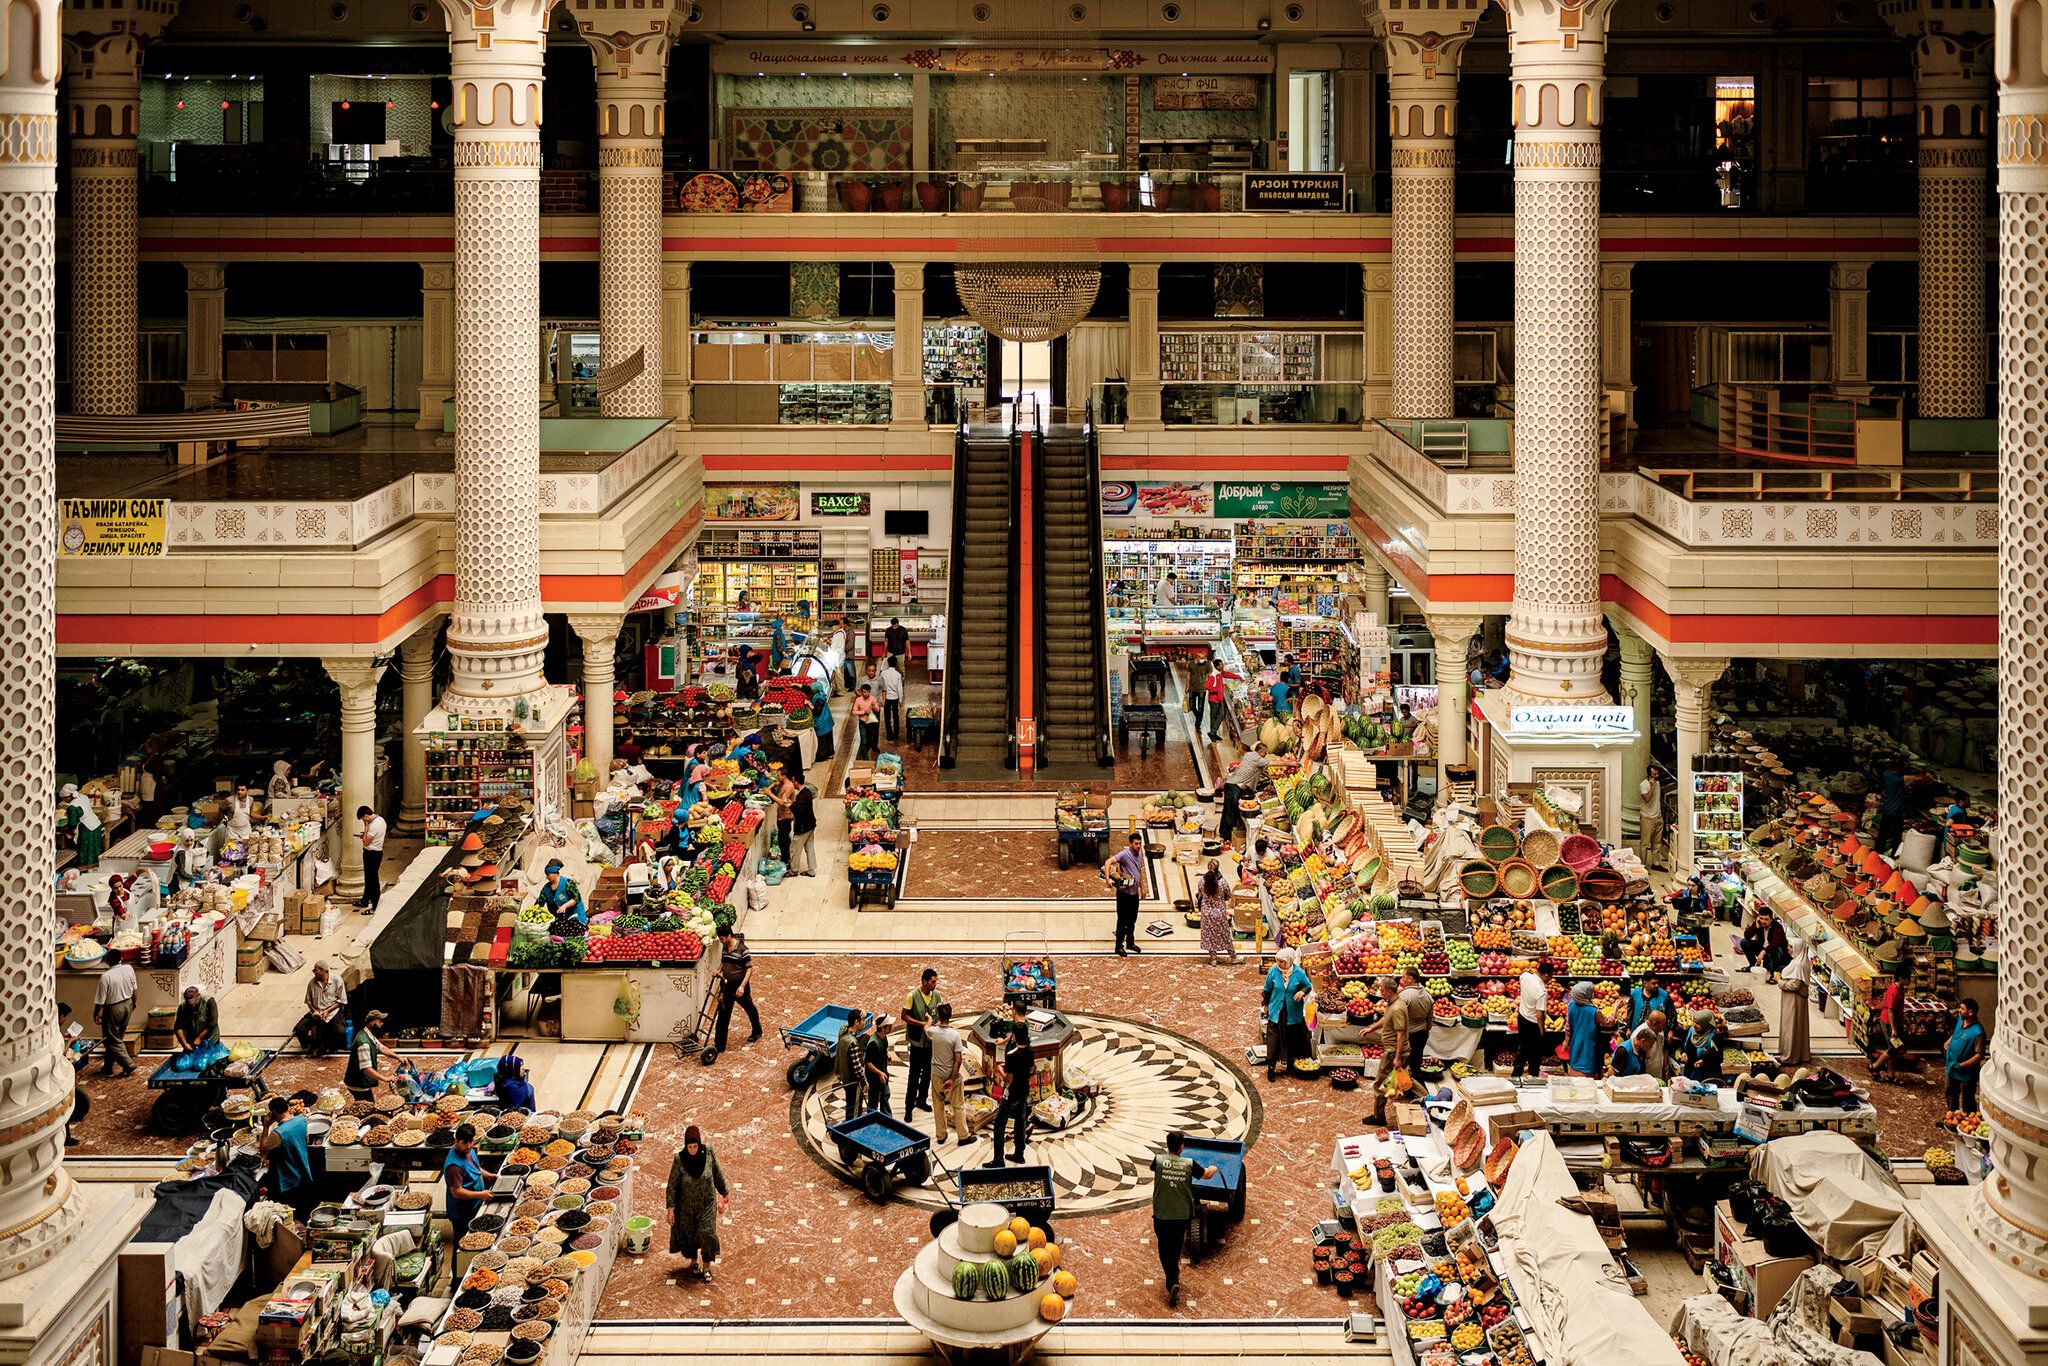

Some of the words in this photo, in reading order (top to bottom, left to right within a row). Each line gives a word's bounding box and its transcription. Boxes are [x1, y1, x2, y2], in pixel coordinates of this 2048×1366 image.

[749, 51, 847, 65] Национальная
[853, 54, 889, 65] кухня
[1222, 55, 1269, 63] милли
[1162, 78, 1191, 89] ФАСТ
[1196, 78, 1218, 89] ФУД
[1250, 180, 1290, 189] АРЗОН
[1291, 180, 1339, 189] ТУРКИЯ
[1297, 191, 1330, 200] МАРДОНА
[63, 500, 127, 519] ТАЪМИРИ
[131, 499, 164, 518] СОАТ
[80, 542, 125, 556] РЕМОНТ
[128, 541, 163, 556] ЧАСОВ
[1514, 711, 1584, 723] Олами
[1592, 711, 1626, 723] чой
[1039, 1199, 1052, 1208] 32
